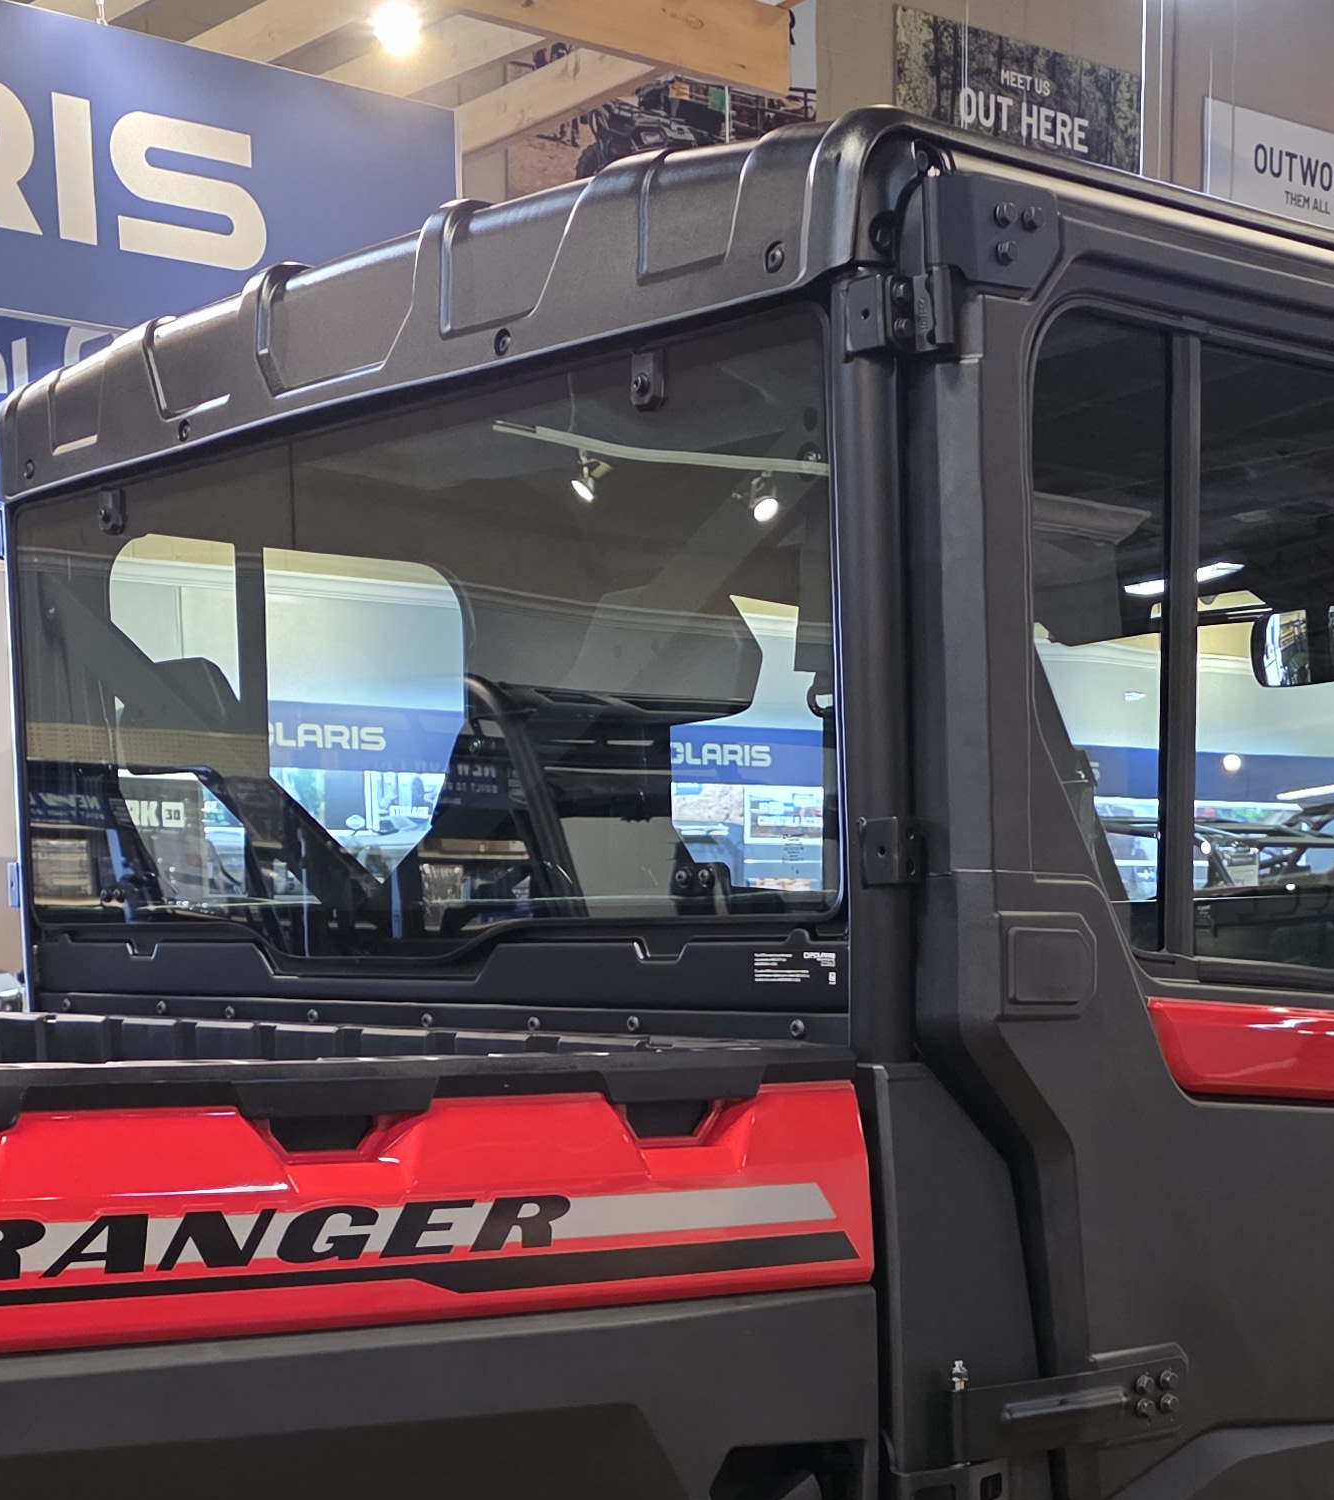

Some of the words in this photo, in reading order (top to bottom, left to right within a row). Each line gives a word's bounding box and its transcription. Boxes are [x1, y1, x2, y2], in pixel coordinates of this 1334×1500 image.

[1001, 68, 1033, 91] MEET
[1034, 78, 1051, 97] US
[959, 87, 1013, 132] OUT
[1021, 102, 1089, 153] HERE
[1284, 190, 1310, 210] THEM
[1312, 198, 1331, 215] ALL
